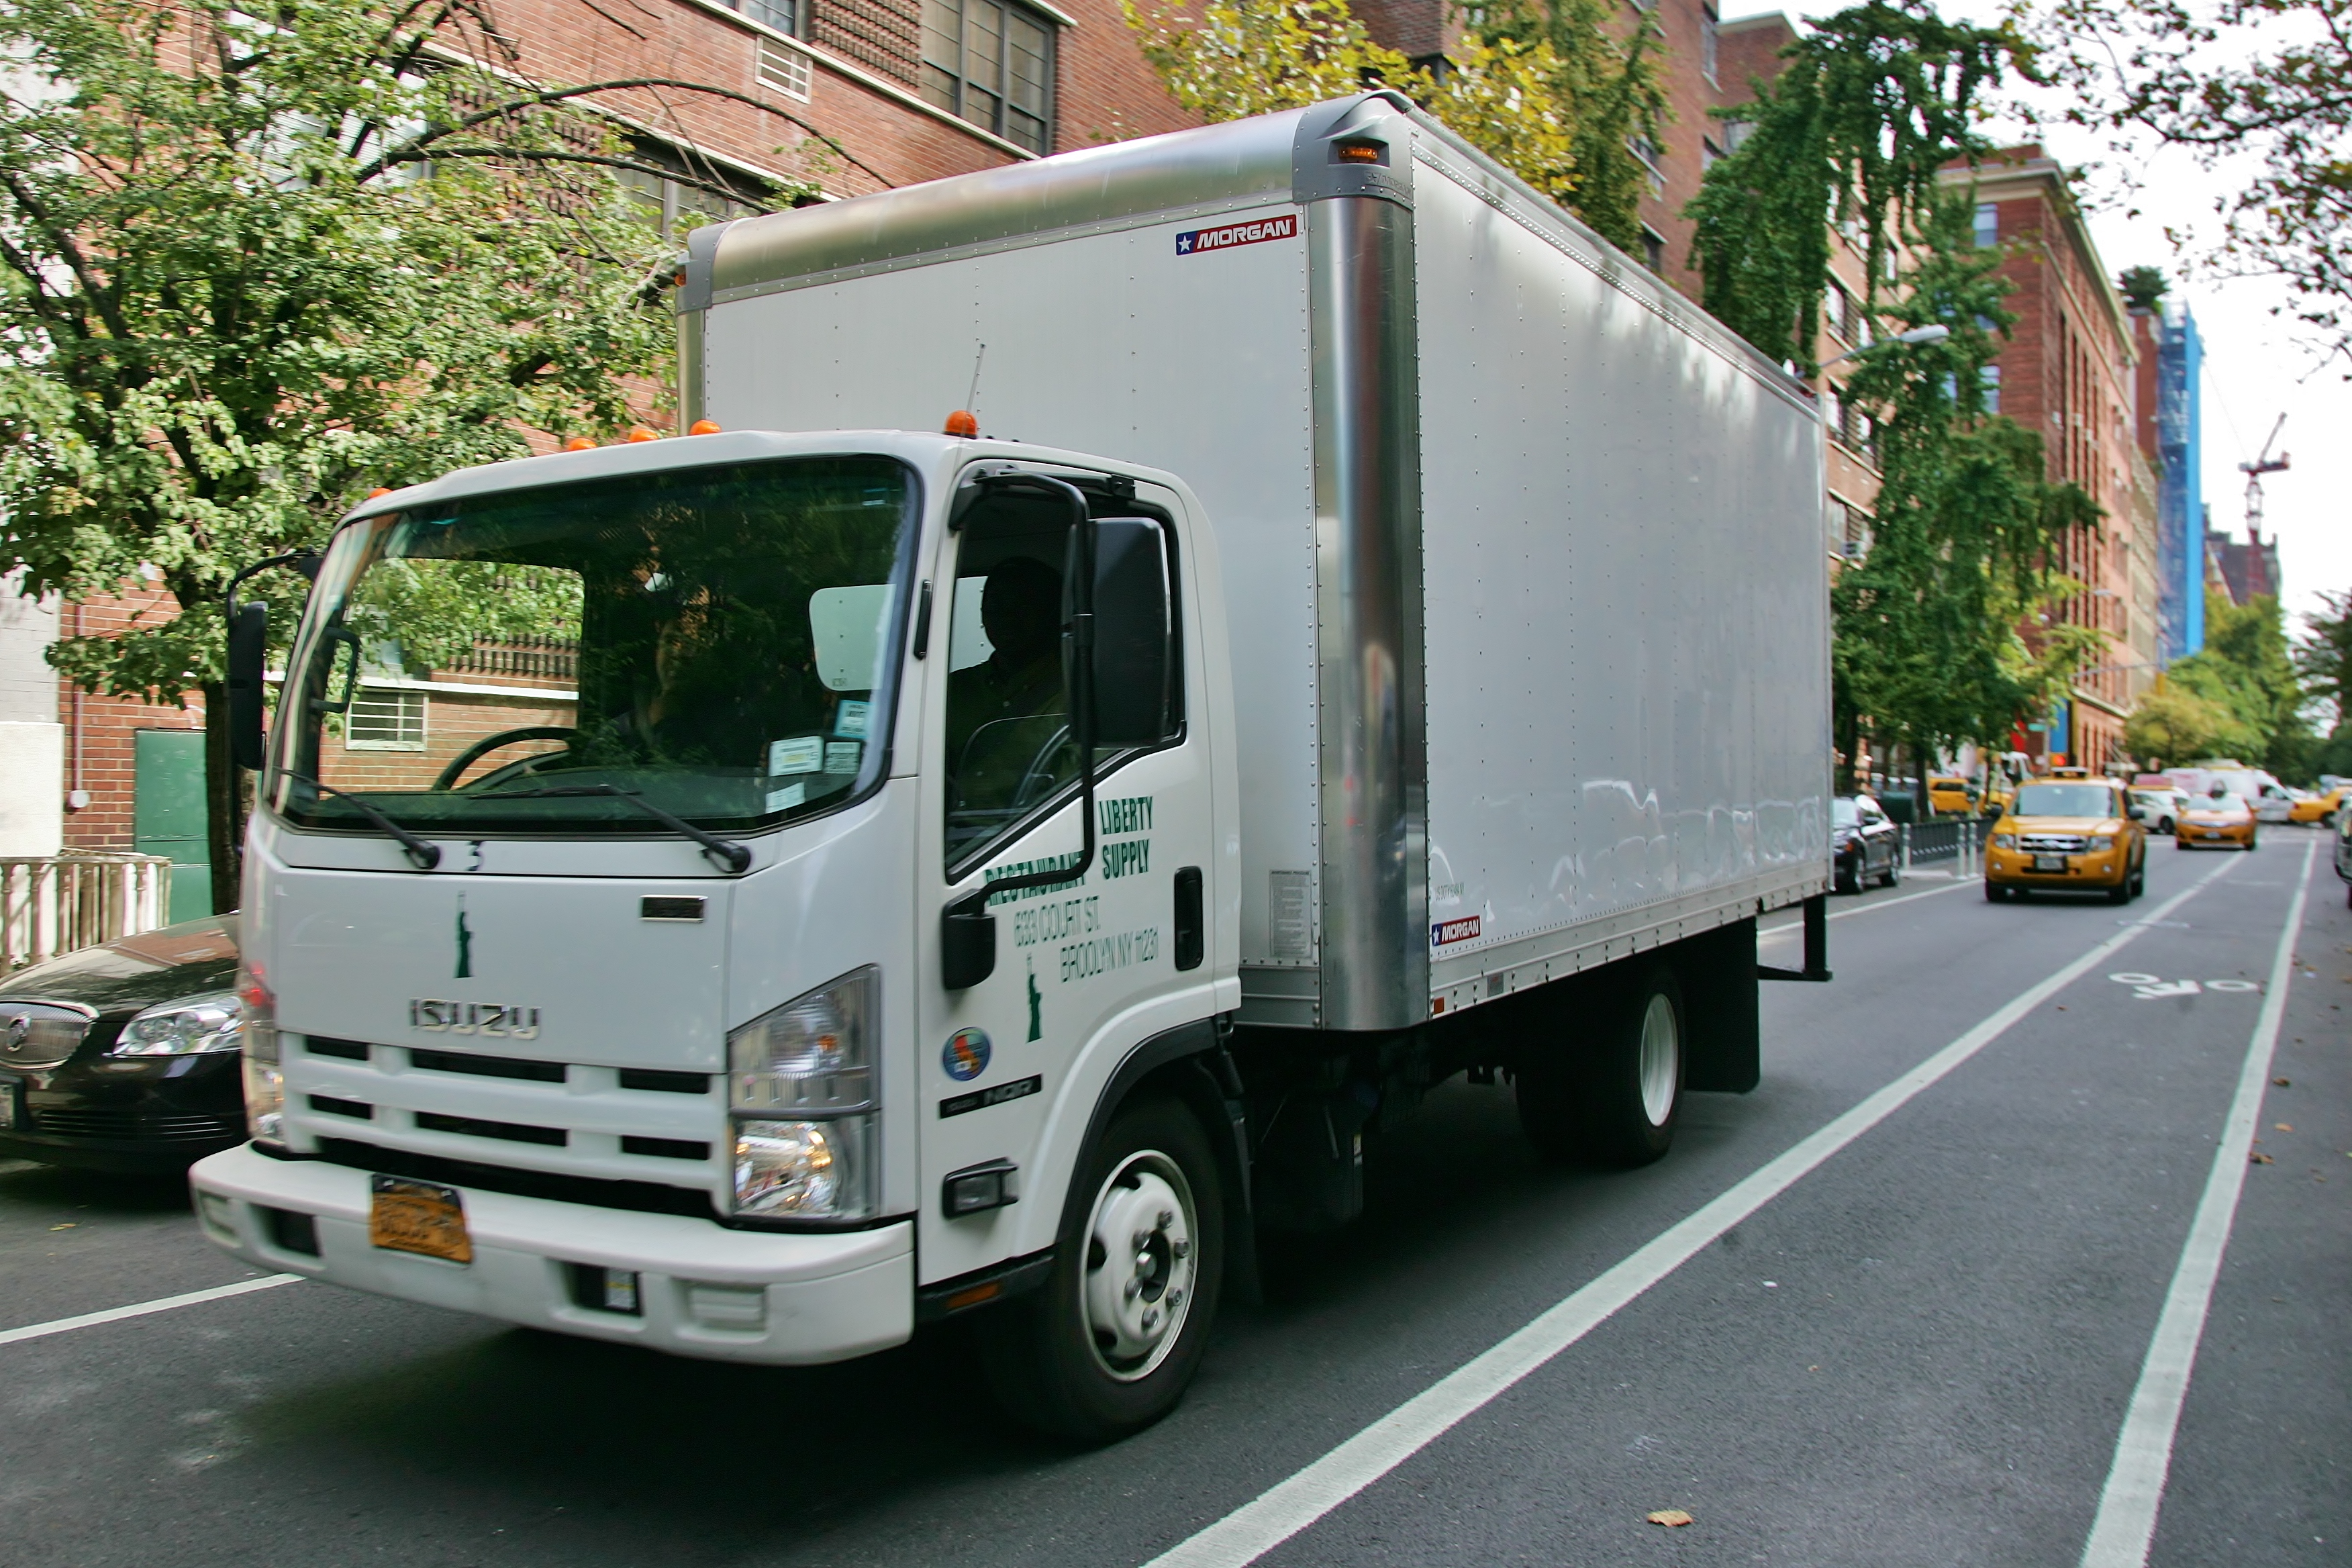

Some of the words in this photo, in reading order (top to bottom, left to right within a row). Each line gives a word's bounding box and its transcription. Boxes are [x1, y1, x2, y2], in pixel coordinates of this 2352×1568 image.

[1196, 218, 1291, 249] MORGAN
[1098, 796, 1154, 835] LIBERTY
[1102, 839, 1150, 880] SUPPLY
[1038, 898, 1083, 942] COURT
[1084, 895, 1101, 934] ST.
[1441, 919, 1479, 942] MORGAN
[1118, 931, 1134, 970] NY
[409, 997, 542, 1040] ISUZU
